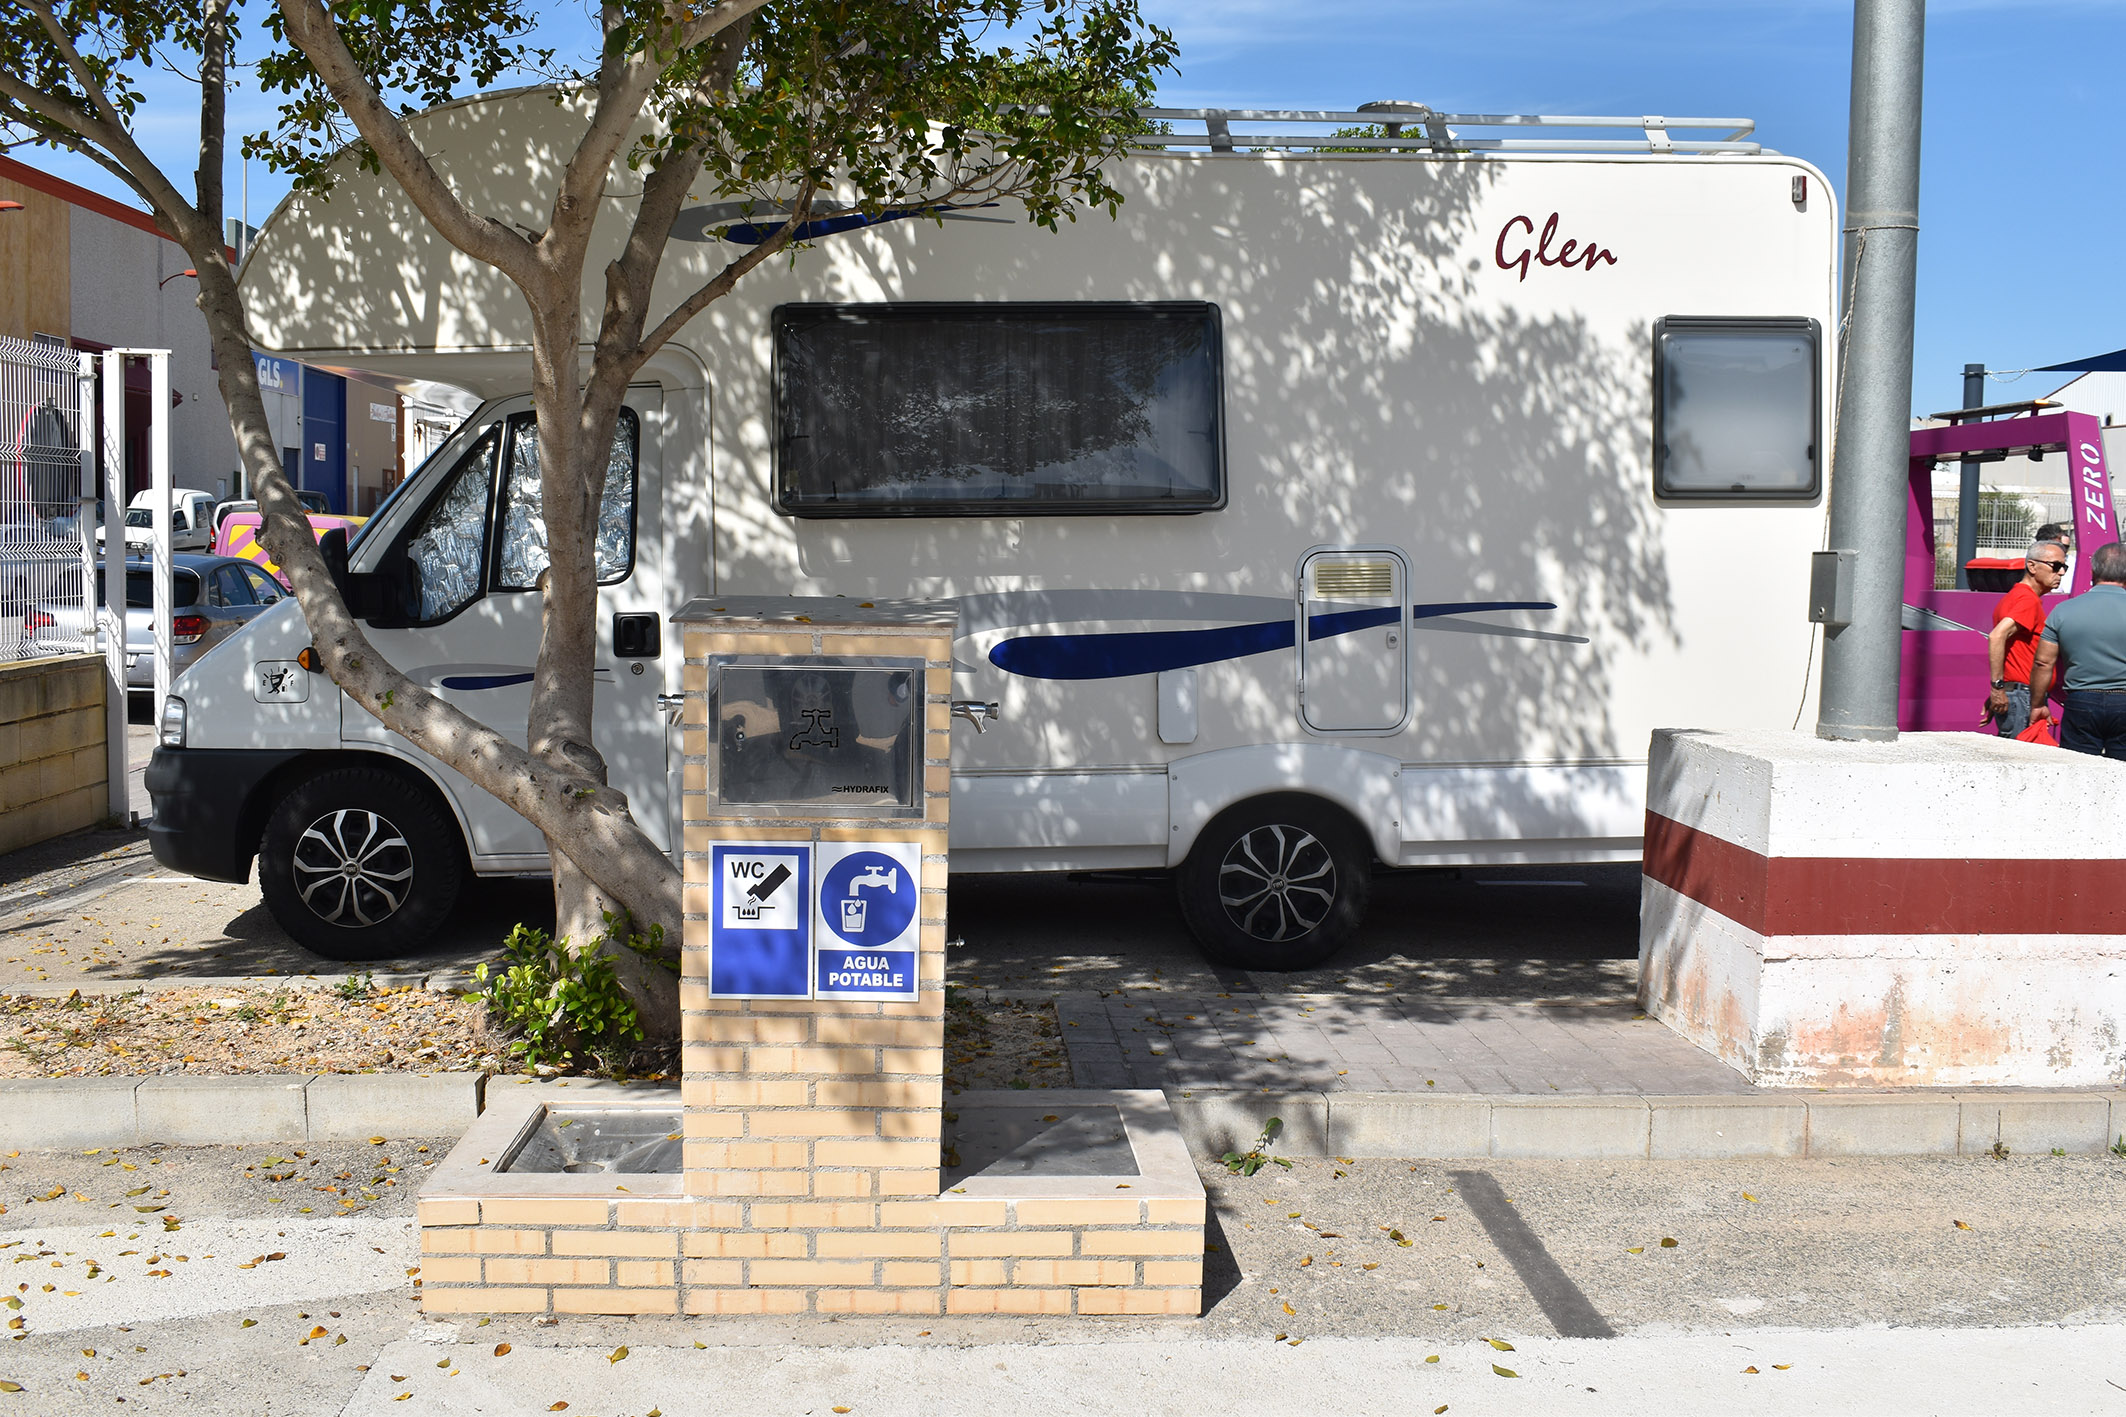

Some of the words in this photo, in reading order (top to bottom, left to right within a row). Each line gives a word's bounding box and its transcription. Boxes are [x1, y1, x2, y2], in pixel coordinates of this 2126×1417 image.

[1495, 212, 1618, 283] Glen
[2080, 442, 2107, 531] ZERO
[843, 785, 889, 794] HYDRAFIX
[731, 861, 765, 879] WC
[843, 955, 890, 970] AGUA
[828, 972, 904, 987] POTABLE
